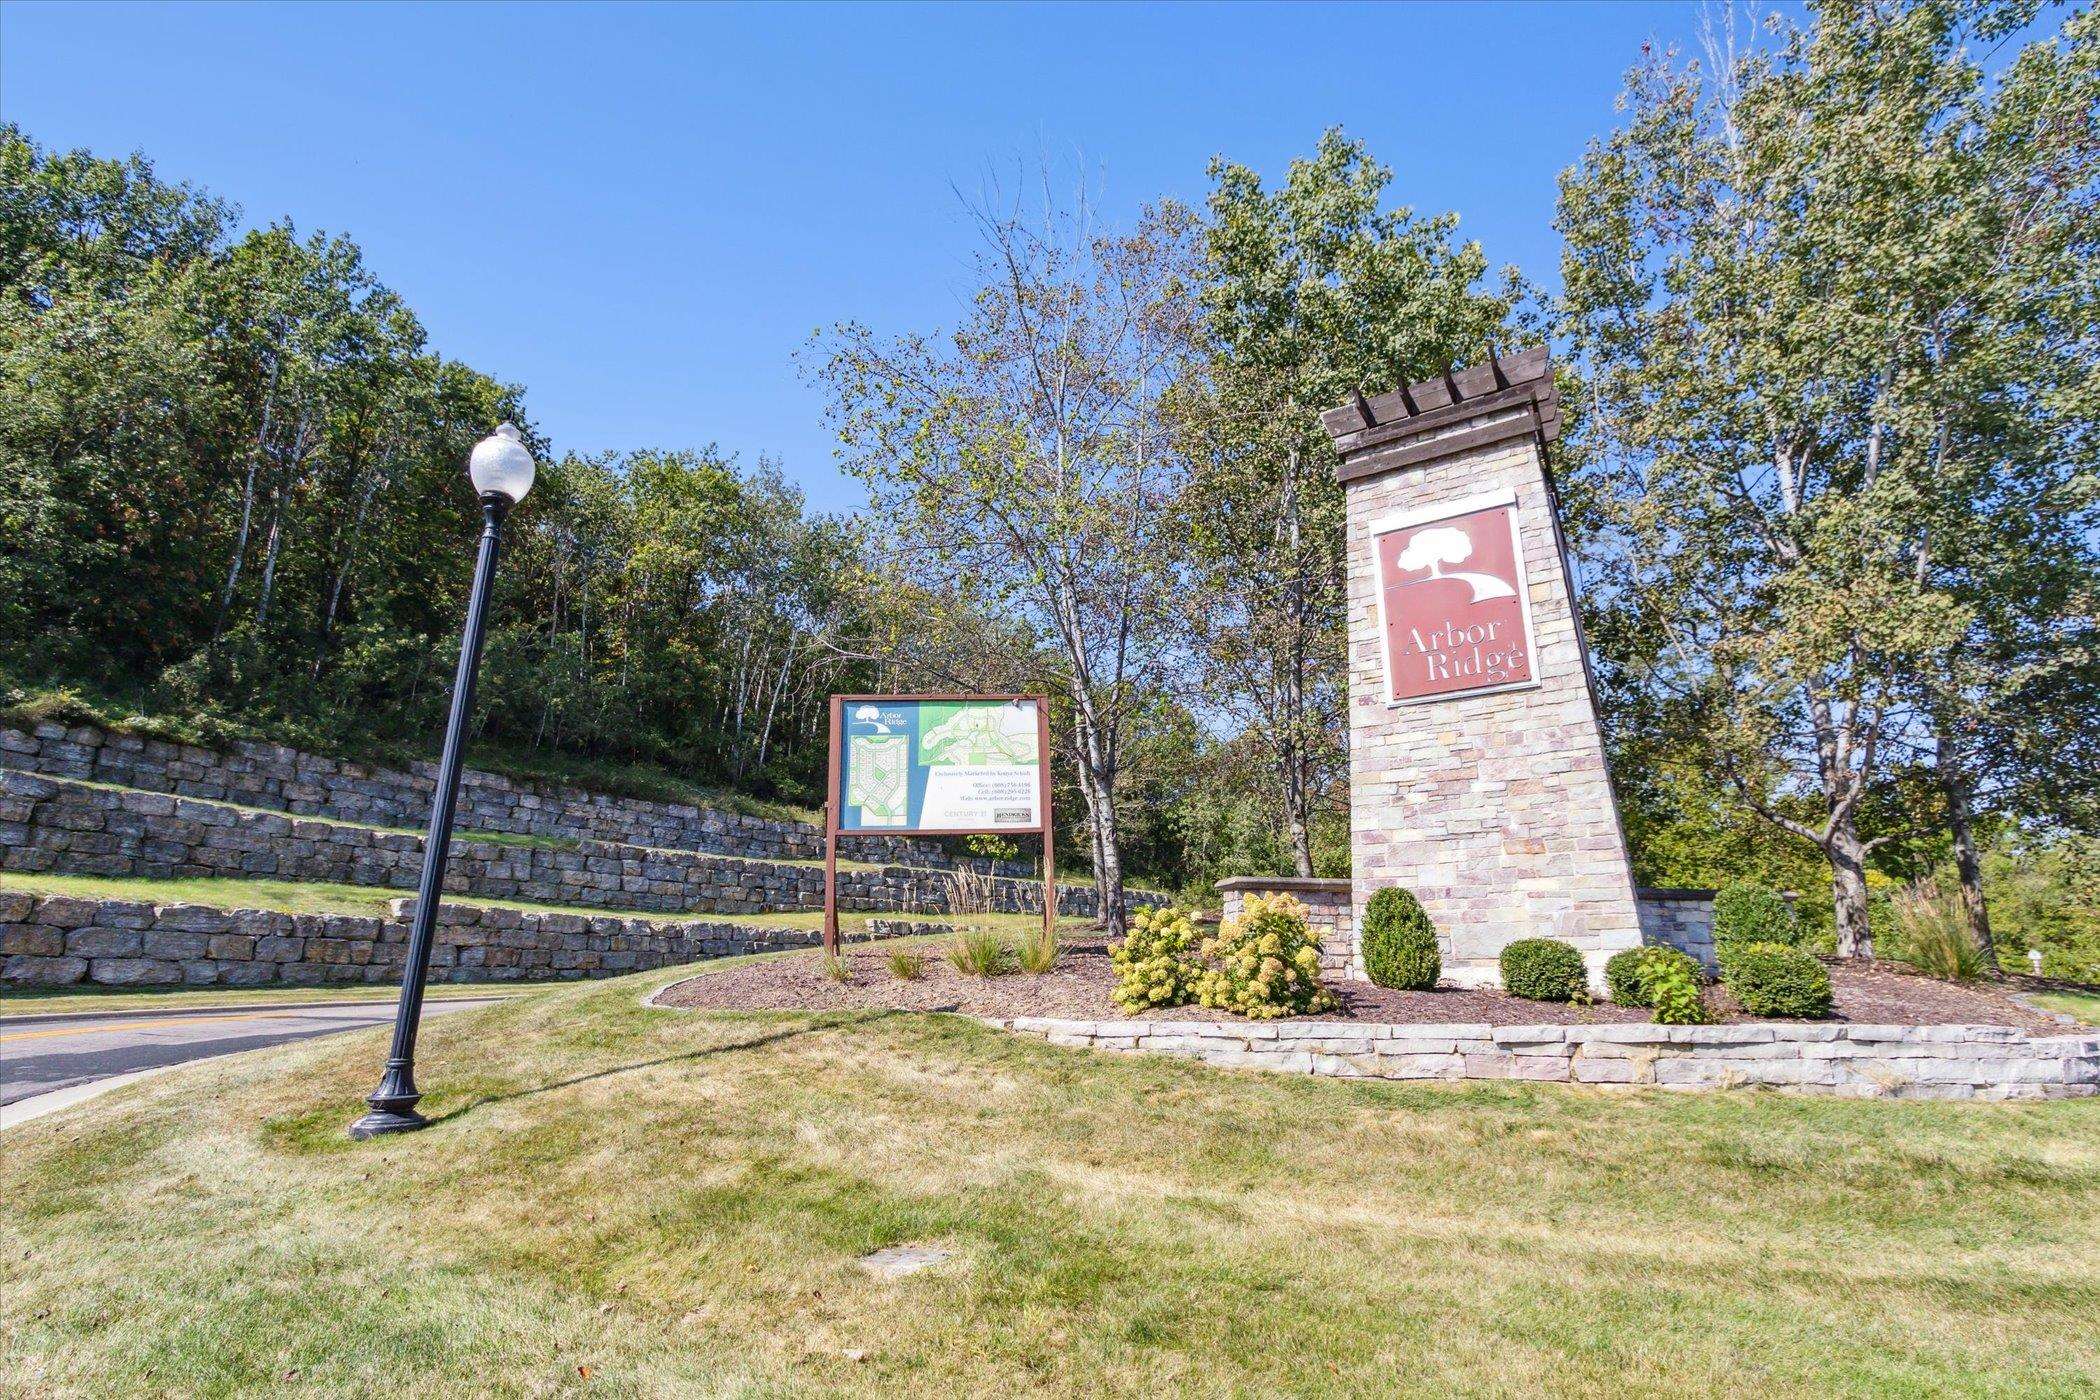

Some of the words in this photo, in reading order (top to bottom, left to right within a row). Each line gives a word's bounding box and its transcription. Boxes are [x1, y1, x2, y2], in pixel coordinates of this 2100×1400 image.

[1402, 616, 1504, 655] Arbor
[1427, 646, 1524, 683] Ridge
[879, 711, 902, 720] Arbor
[884, 718, 908, 728] Ridge
